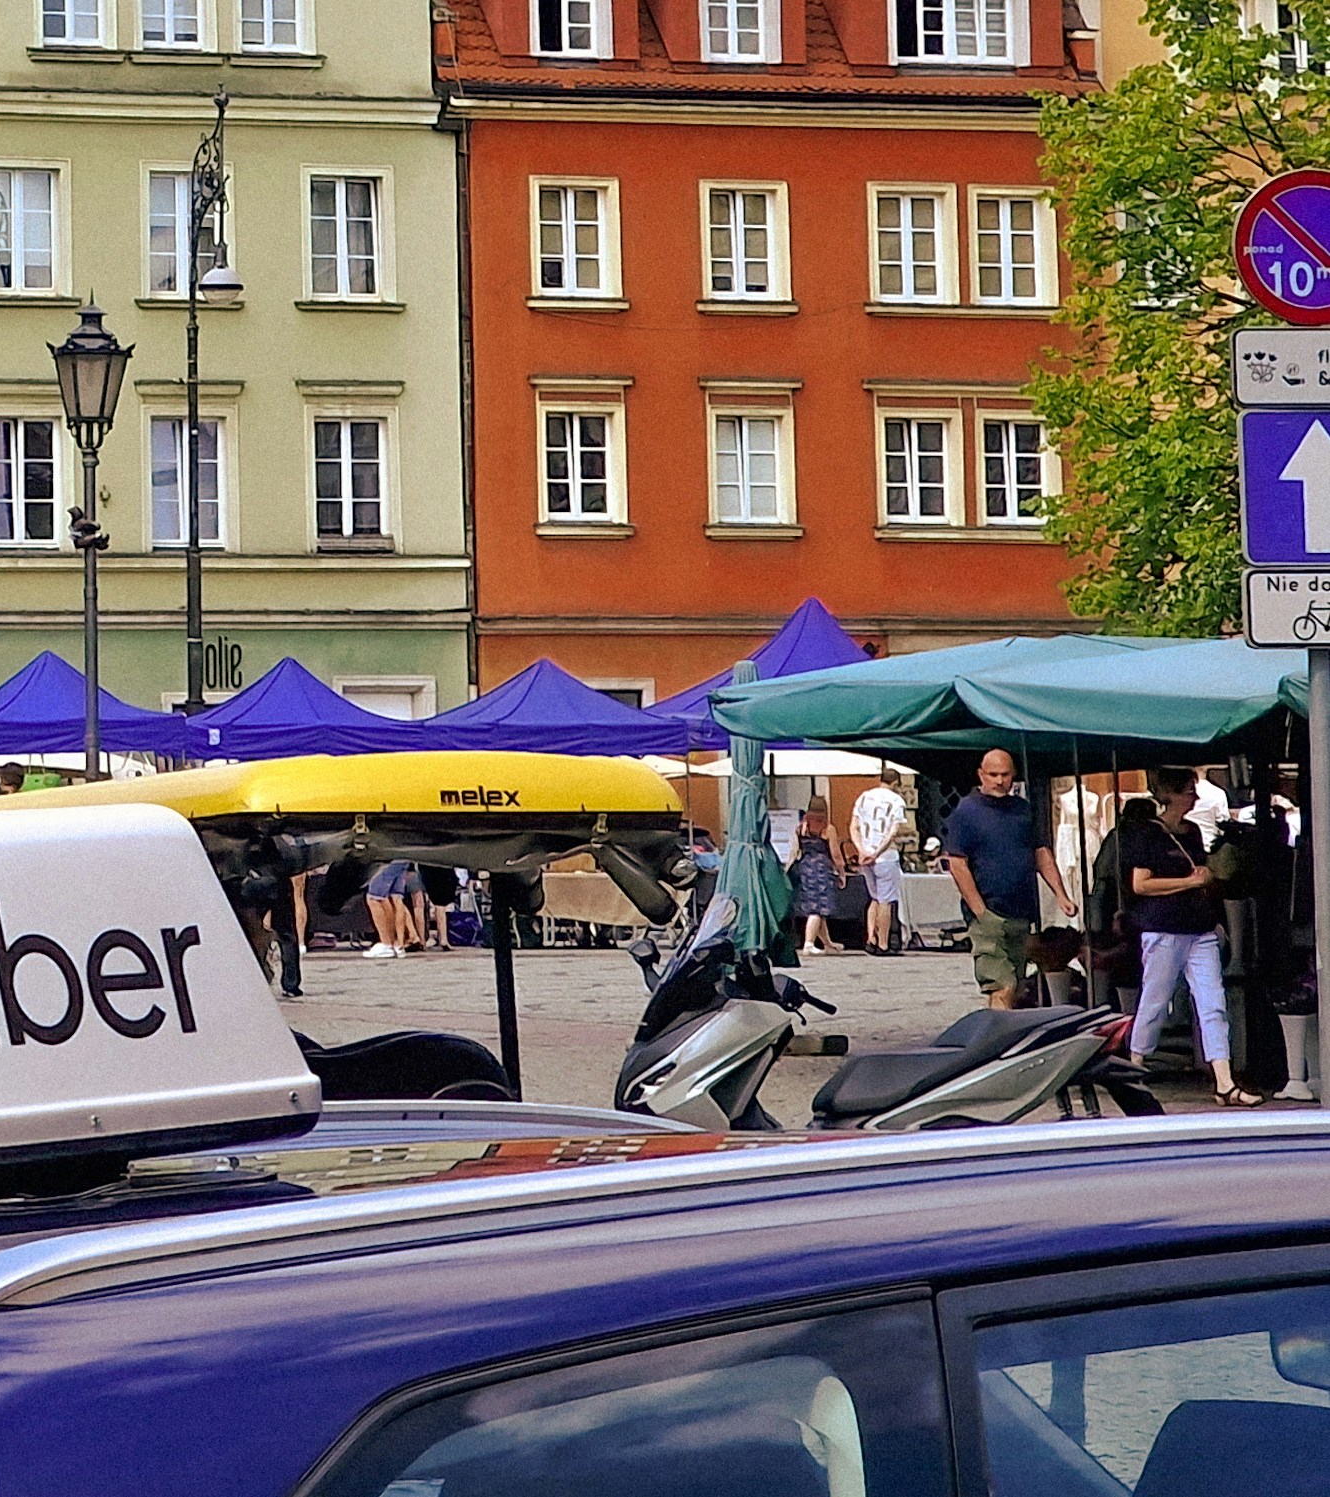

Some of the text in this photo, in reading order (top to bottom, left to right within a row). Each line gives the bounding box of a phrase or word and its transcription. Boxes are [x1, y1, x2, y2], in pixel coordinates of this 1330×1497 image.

[1243, 244, 1284, 256] ponad
[1268, 261, 1315, 298] 10
[1267, 576, 1299, 592] Nie
[439, 785, 521, 807] melex
